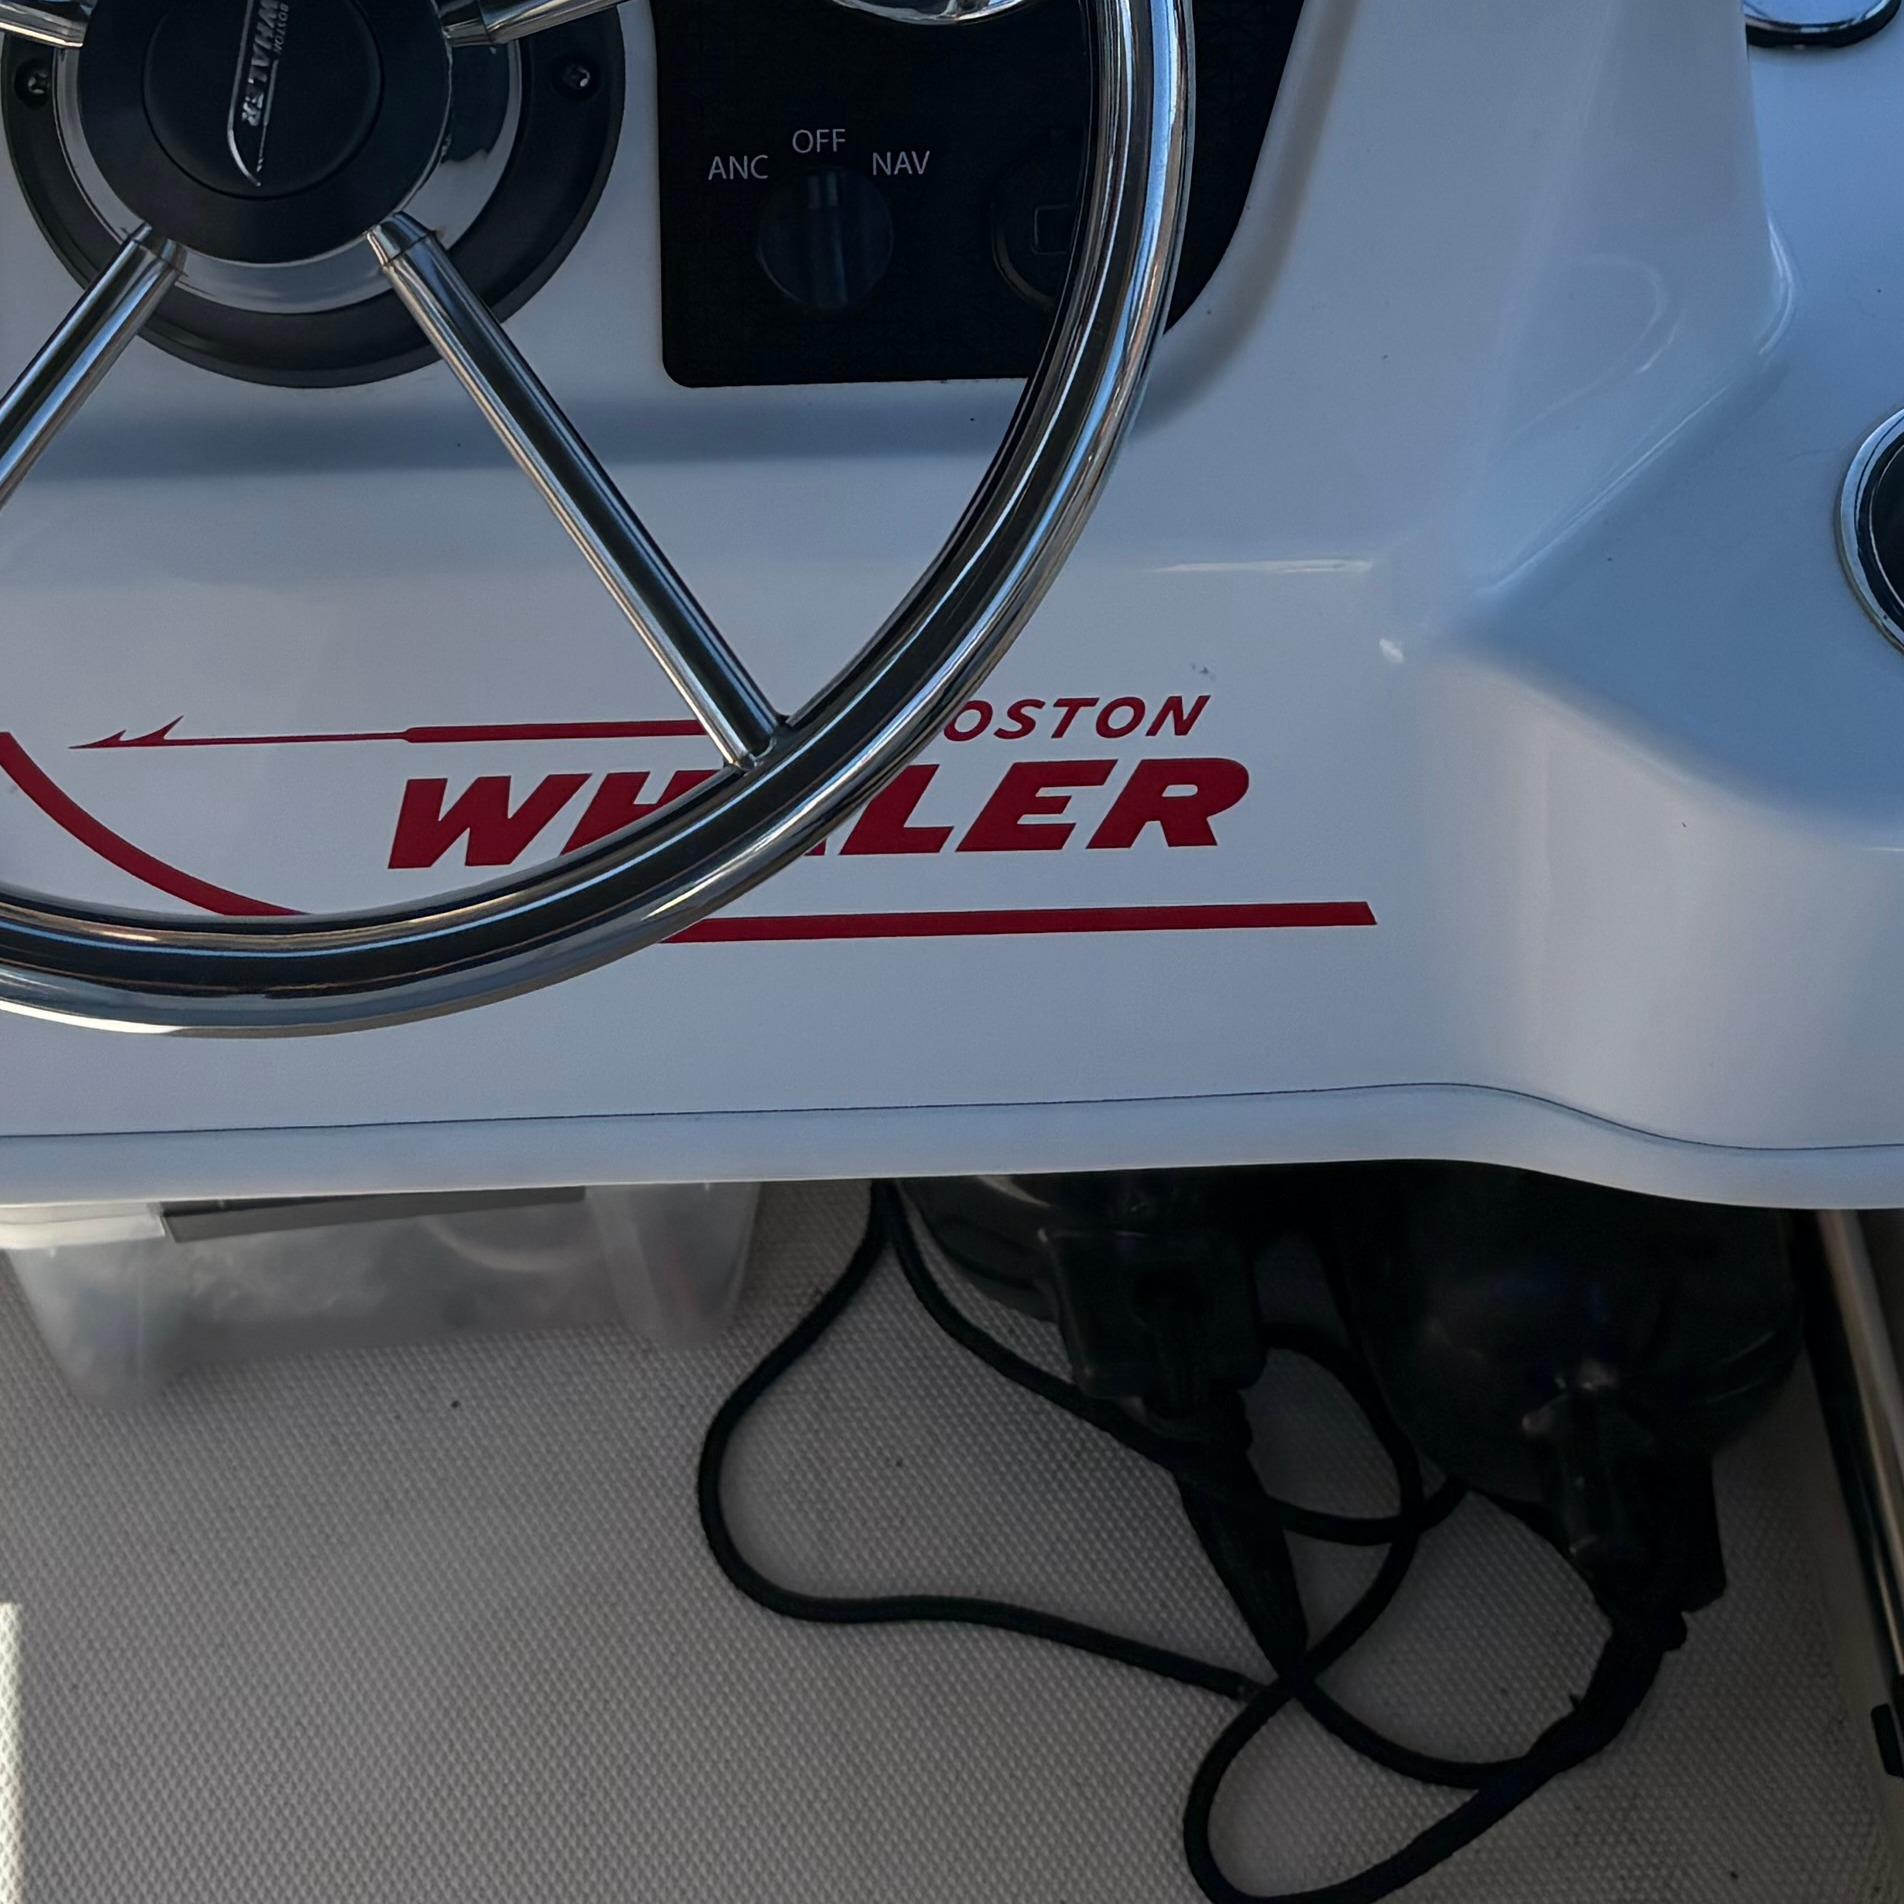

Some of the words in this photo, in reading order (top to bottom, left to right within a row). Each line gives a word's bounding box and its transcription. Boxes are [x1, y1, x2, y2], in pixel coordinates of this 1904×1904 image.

[273, 2, 289, 56] BOSTON
[792, 128, 846, 153] OFF
[708, 154, 769, 181] ANC
[872, 150, 931, 176] NAV
[943, 694, 1211, 742] OSTON
[387, 756, 1250, 870] WHLER
